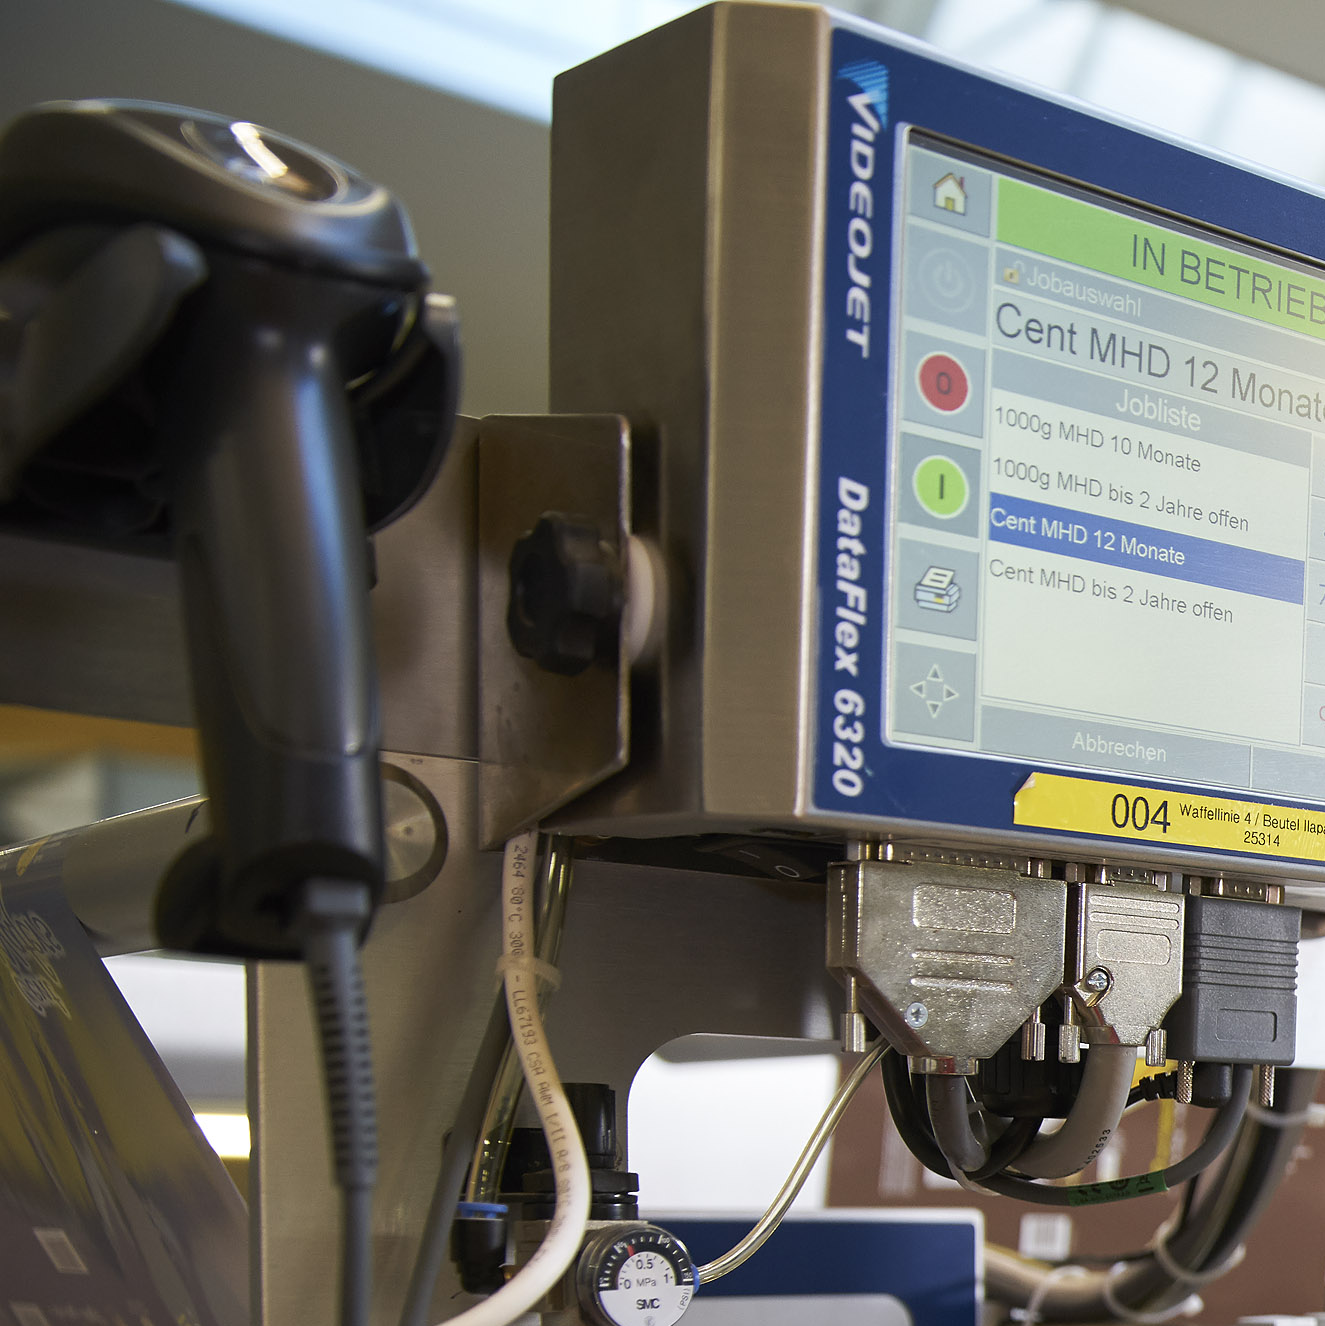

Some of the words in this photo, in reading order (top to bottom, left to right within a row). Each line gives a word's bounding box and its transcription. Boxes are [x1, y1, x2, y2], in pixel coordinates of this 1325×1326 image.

[845, 89, 881, 360] VIDEOJET
[1132, 234, 1166, 276] IN
[1026, 267, 1142, 318] Jobauswahl
[996, 302, 1078, 356] Cent
[1089, 327, 1170, 379] MHD
[1185, 355, 1219, 394] 12
[1115, 388, 1202, 432] Jobliste
[994, 406, 1052, 440] 1000g
[1059, 420, 1104, 449] MHD
[1110, 435, 1132, 455] 10
[1137, 440, 1201, 473] Monate
[993, 457, 1051, 490] 1000g
[1057, 471, 1103, 498] MHD
[1108, 483, 1134, 505] bis
[1139, 491, 1151, 510] 2
[1155, 496, 1203, 522] Jahre
[1208, 509, 1250, 533] offen
[990, 507, 1037, 535] Cent
[1041, 517, 1087, 544] MHD
[1093, 530, 1116, 552] 12
[1120, 535, 1186, 566] Monate
[834, 476, 870, 678] DataFlex
[989, 558, 1035, 585] Cent
[1040, 568, 1086, 594] MHD
[1091, 578, 1117, 601] bis
[1122, 585, 1134, 604] 2
[1139, 589, 1187, 615] Jahre
[1191, 600, 1234, 624] offen
[831, 688, 866, 798] 6320
[1071, 731, 1168, 764] Abbrechen
[1111, 793, 1172, 835] 004
[1179, 802, 1241, 825] Waffellinie
[1243, 810, 1253, 825] 4
[1253, 812, 1260, 827] /
[1263, 813, 1300, 832] Beutel
[1243, 831, 1281, 848] 25314
[635, 1258, 654, 1270] 0.5
[635, 1277, 657, 1288] MPa
[636, 1297, 661, 1311] SMC
